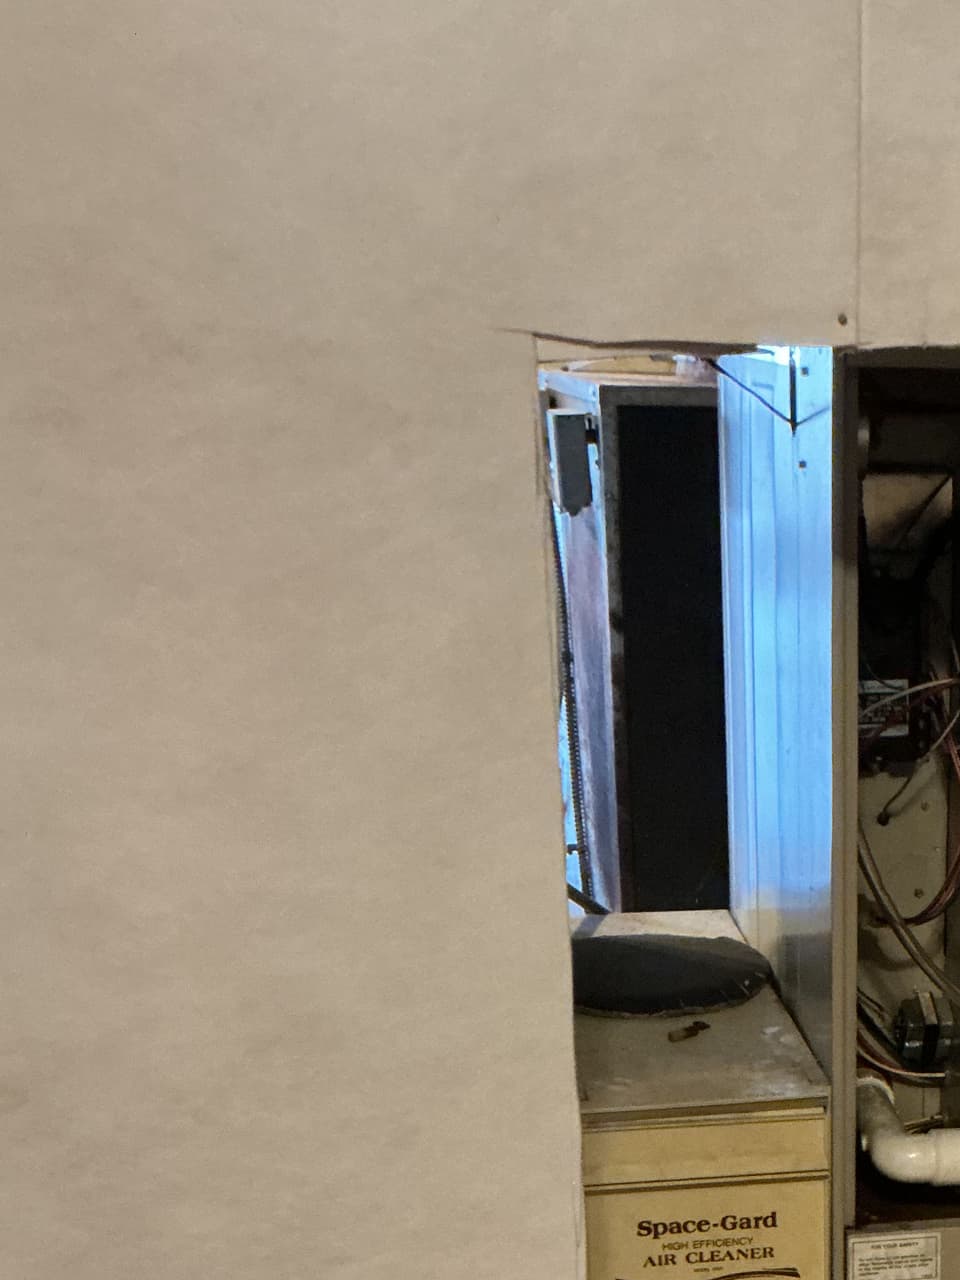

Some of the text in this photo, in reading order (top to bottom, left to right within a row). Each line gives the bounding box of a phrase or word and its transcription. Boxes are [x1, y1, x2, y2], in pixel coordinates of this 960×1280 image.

[637, 1211, 778, 1239] Space-Gard
[662, 1237, 754, 1251] HIGH EFFICIENCY
[643, 1246, 775, 1268] AIR CLEANER
